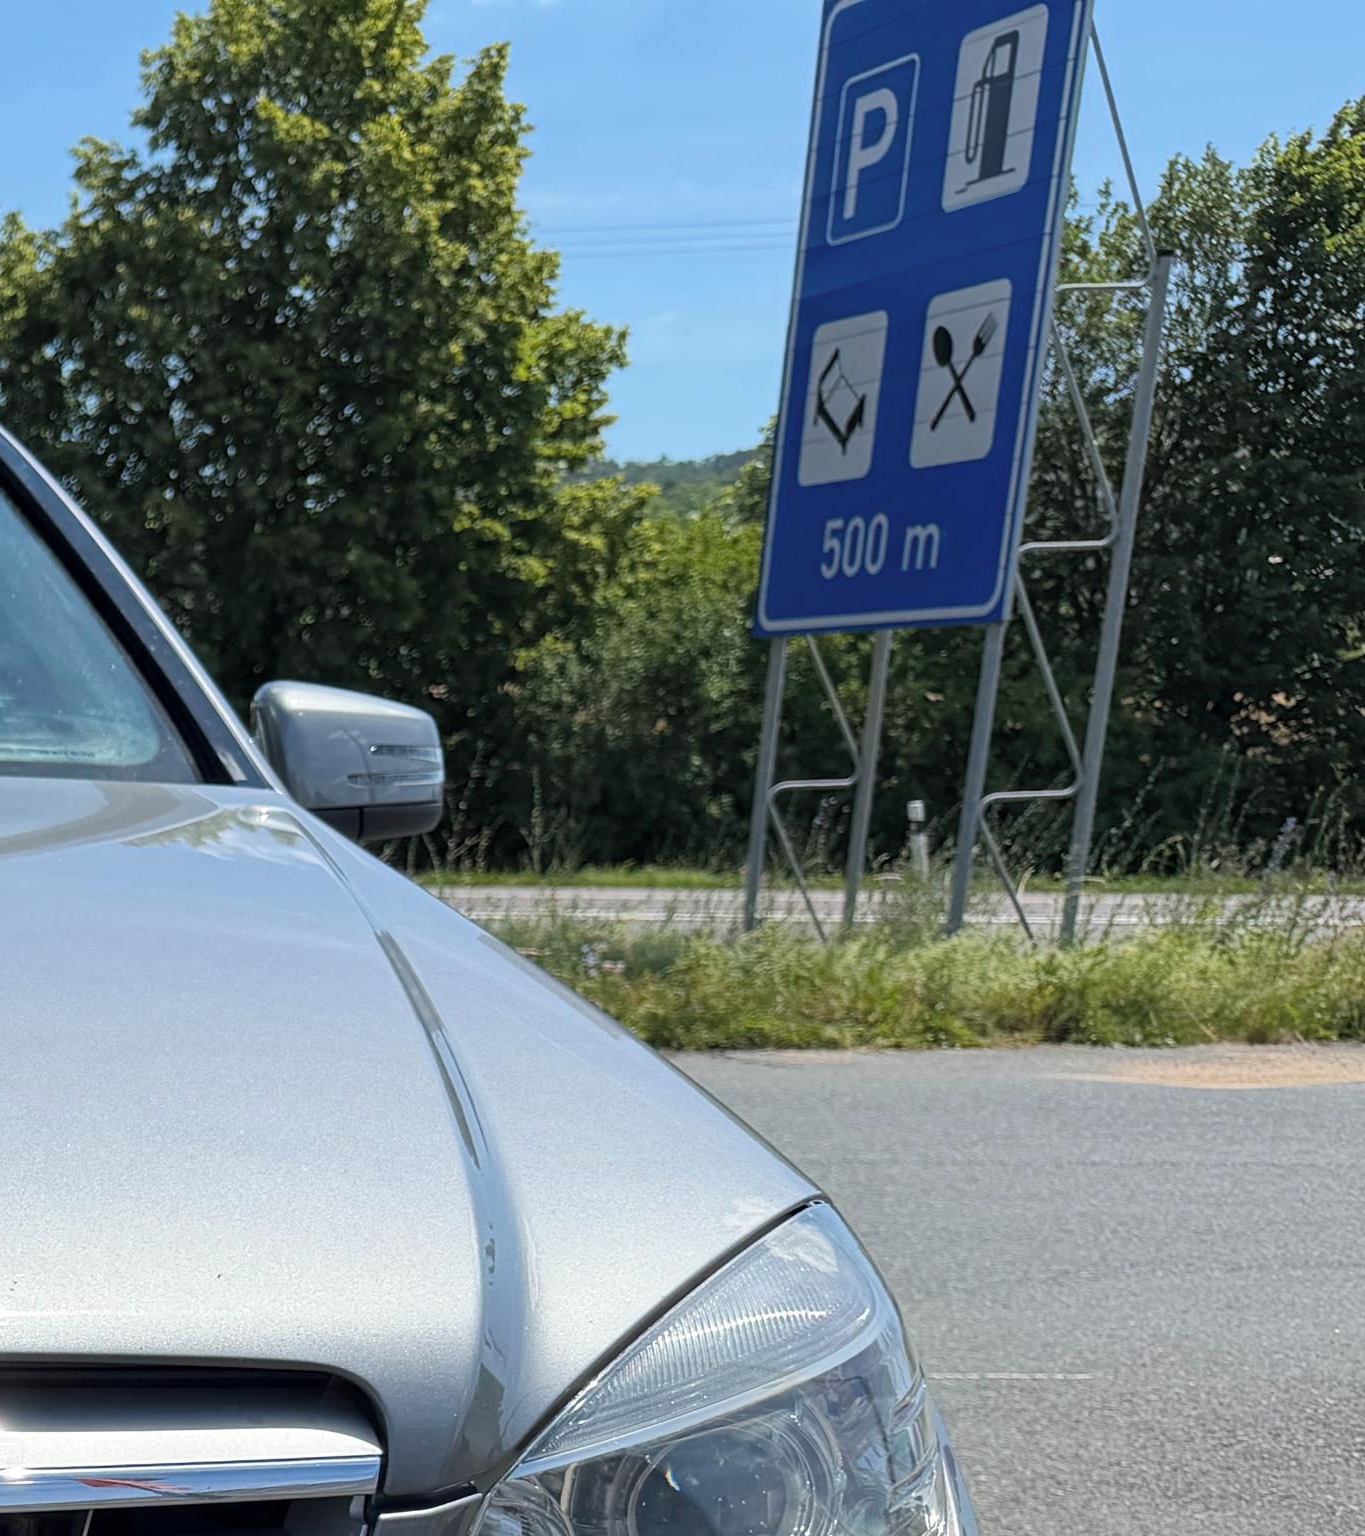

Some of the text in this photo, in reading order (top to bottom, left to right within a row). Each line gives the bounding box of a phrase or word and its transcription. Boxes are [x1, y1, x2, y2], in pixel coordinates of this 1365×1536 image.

[844, 88, 899, 220] P
[820, 512, 940, 580] 500 m
